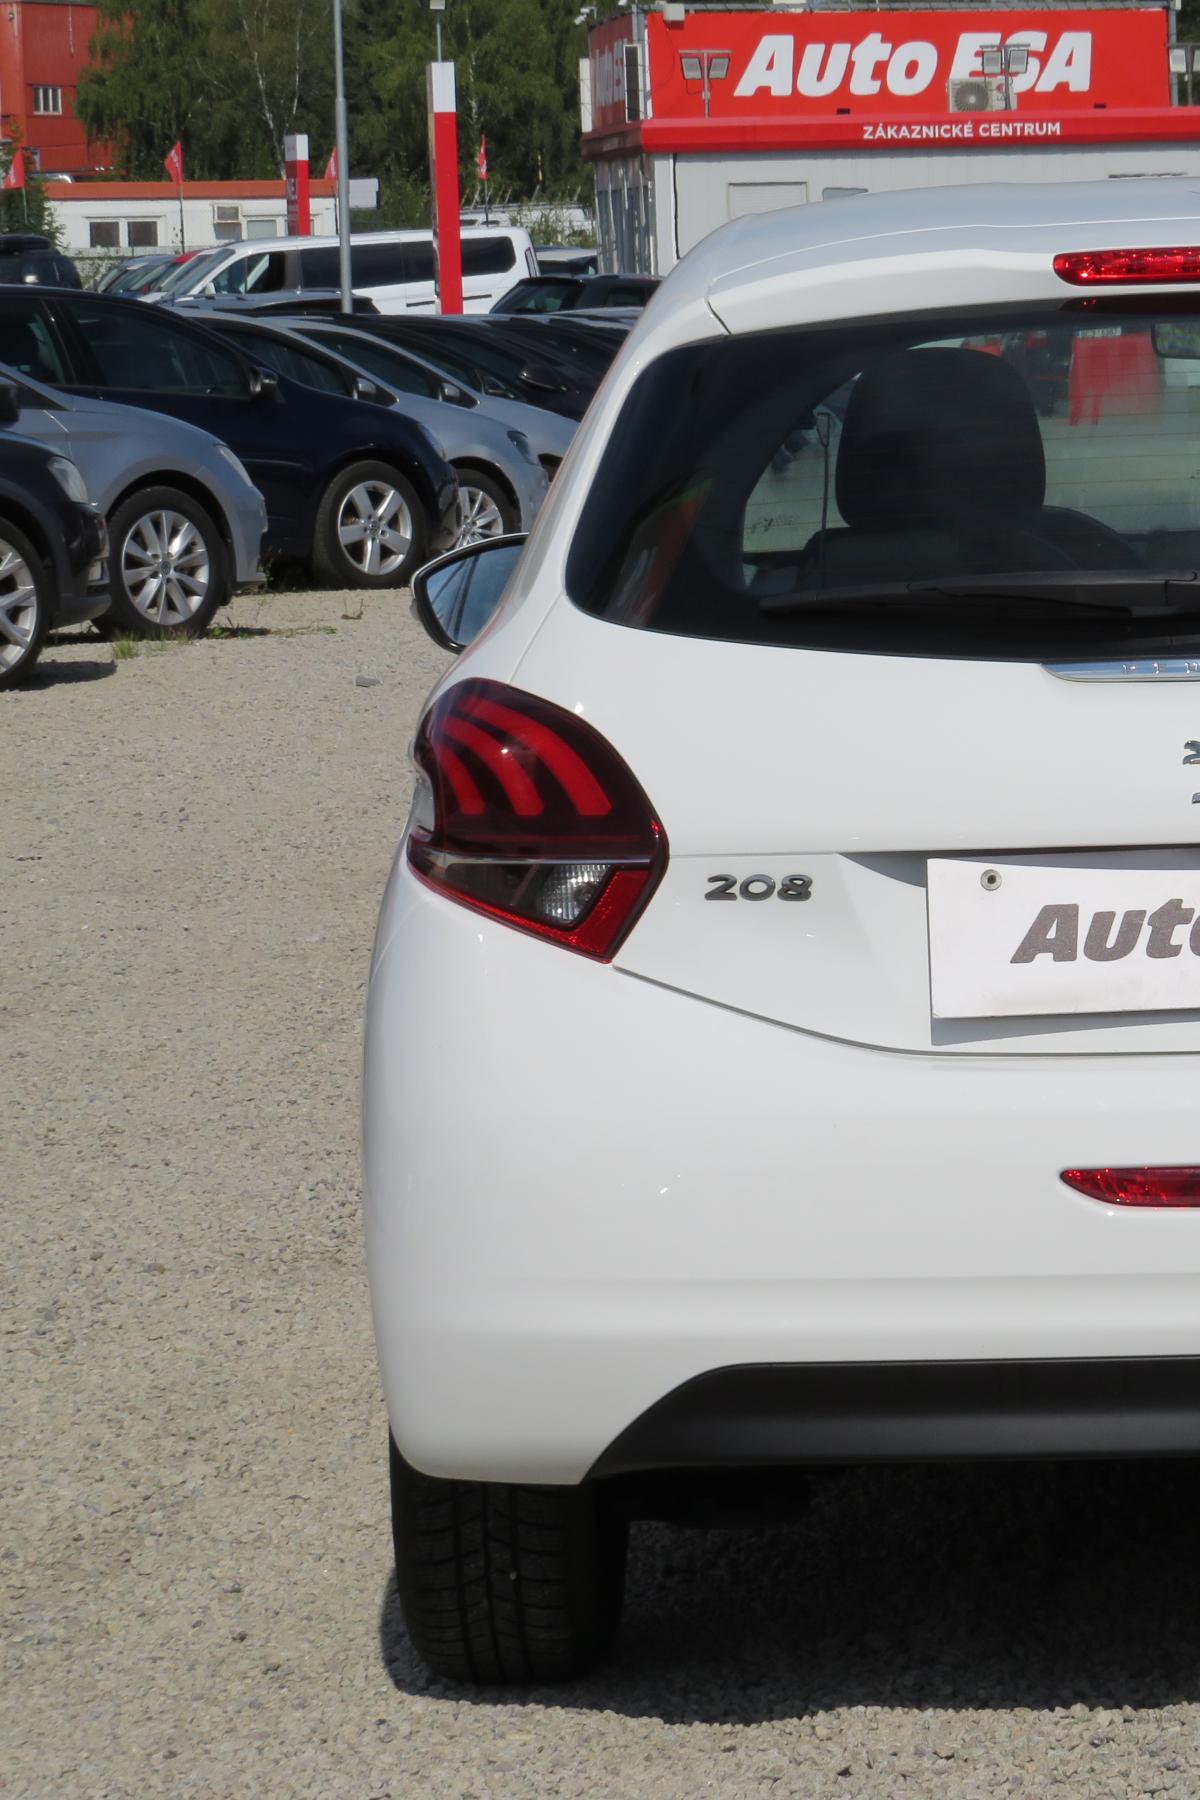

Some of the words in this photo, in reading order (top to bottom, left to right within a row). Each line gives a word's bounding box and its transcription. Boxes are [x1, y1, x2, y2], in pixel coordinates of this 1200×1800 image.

[733, 32, 938, 97] Auto
[948, 31, 1092, 95] ESA
[863, 121, 974, 140] ZÁKAZNICKÉ
[978, 122, 1061, 137] CENTRUM
[704, 873, 813, 902] 208
